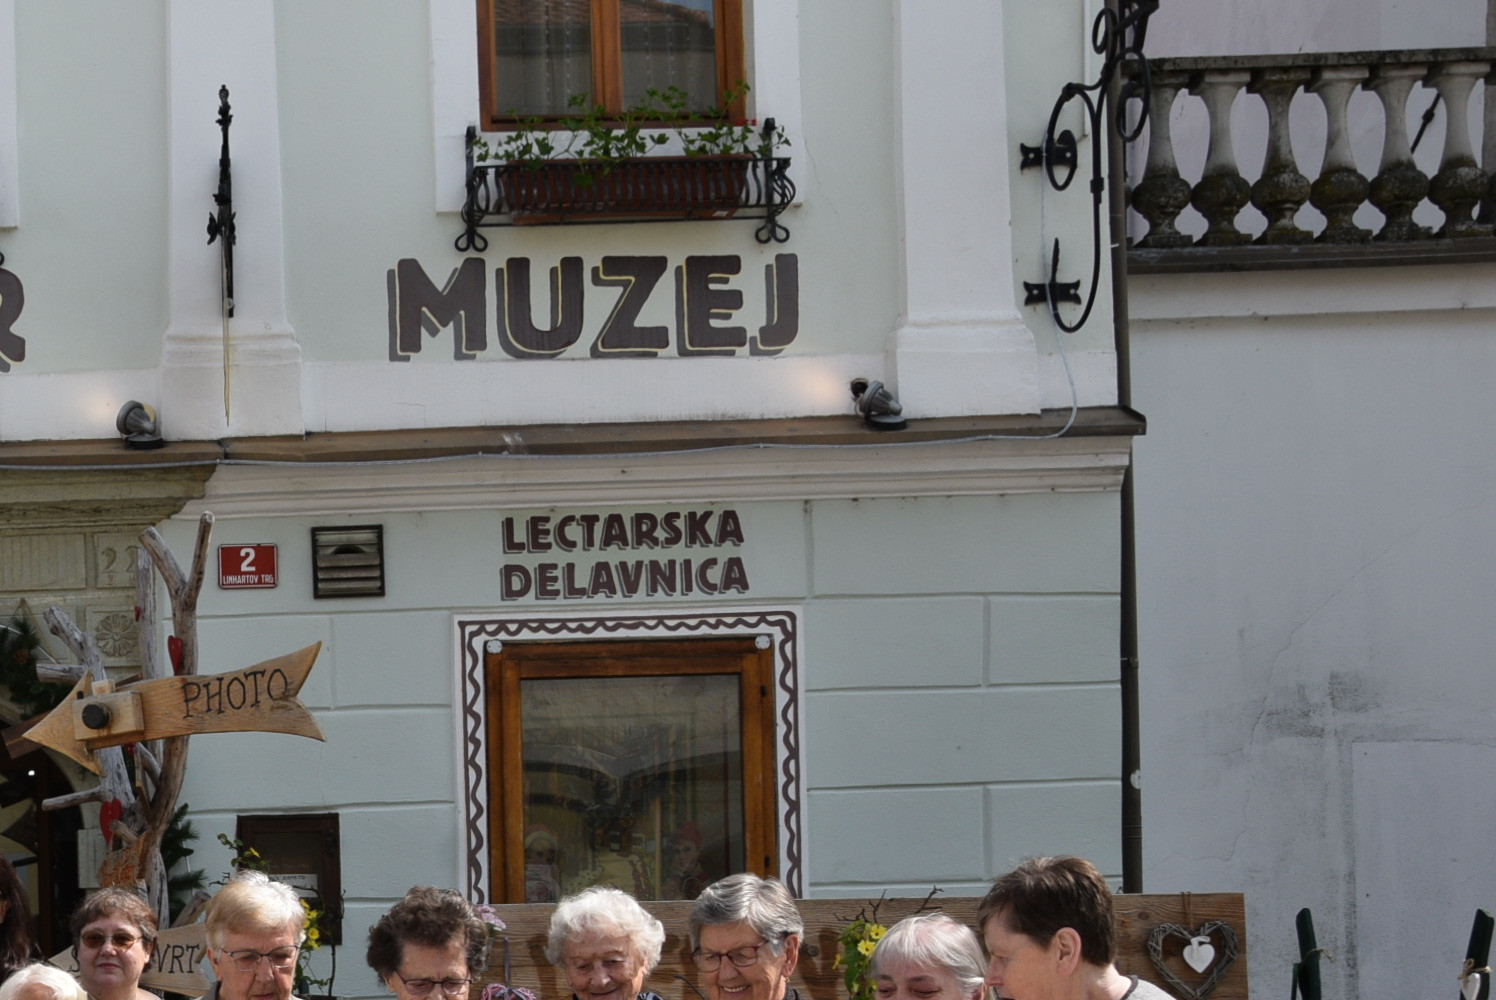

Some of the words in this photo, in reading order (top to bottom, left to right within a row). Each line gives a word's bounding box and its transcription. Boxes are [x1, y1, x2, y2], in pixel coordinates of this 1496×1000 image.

[387, 253, 799, 361] MUZEJ
[502, 510, 745, 555] LECTARSKA
[223, 575, 258, 585] LINHARTOV
[261, 574, 274, 583] TRG
[240, 547, 256, 572] 2
[501, 556, 750, 600] DELAVNICA
[181, 668, 288, 719] PHOTO
